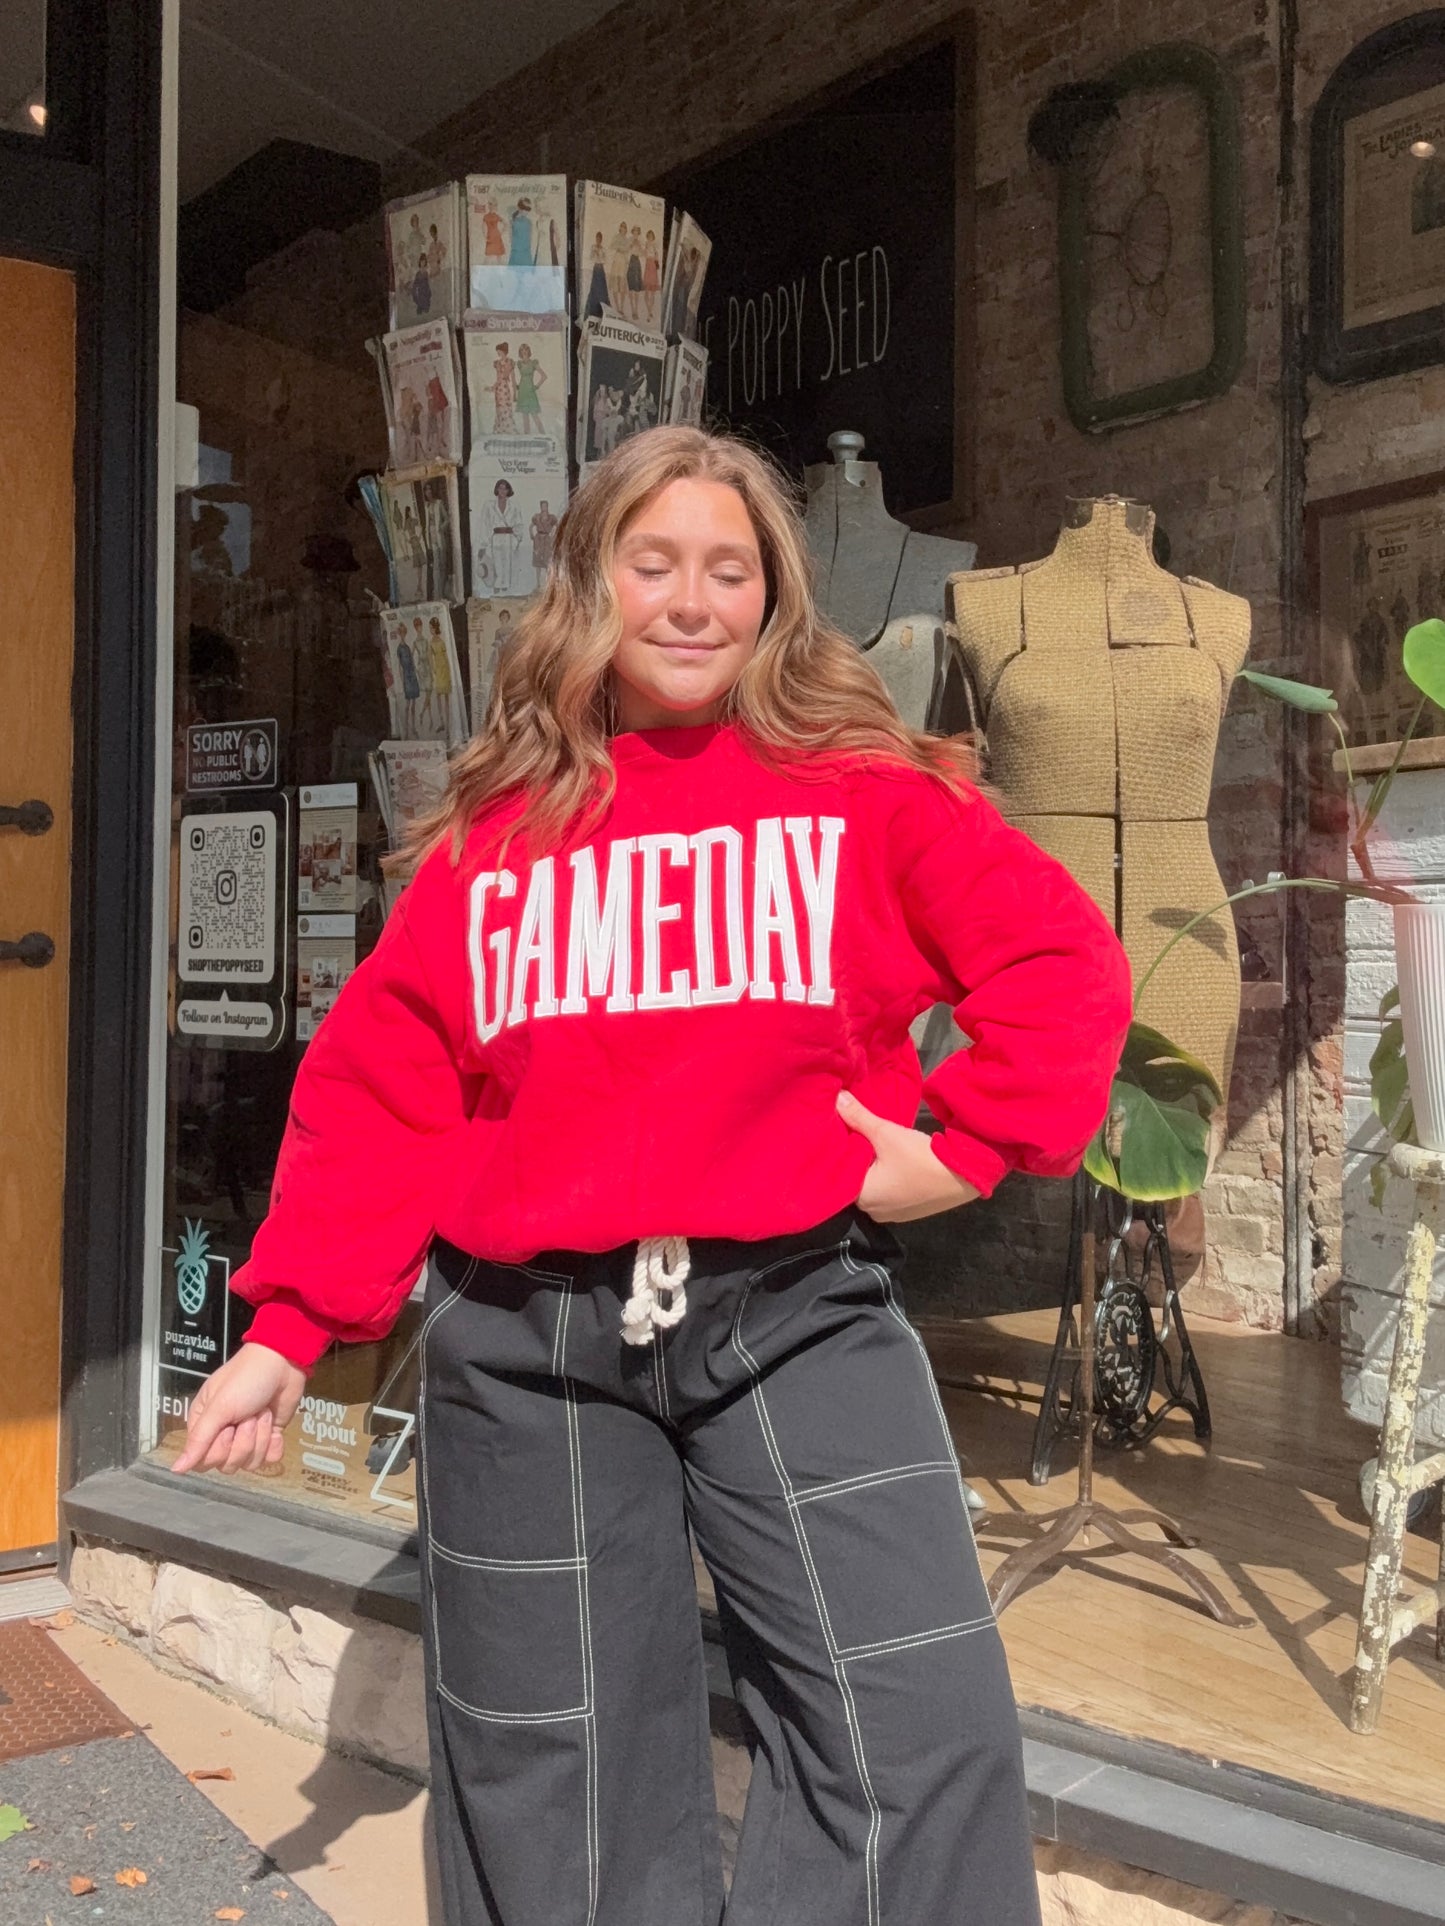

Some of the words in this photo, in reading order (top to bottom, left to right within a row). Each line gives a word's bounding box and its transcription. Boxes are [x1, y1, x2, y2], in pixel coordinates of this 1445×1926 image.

[487, 315, 542, 330] Simplicity
[729, 276, 805, 413] POPPY
[820, 246, 890, 381] SEED
[192, 730, 242, 752] SORRY
[206, 754, 238, 767] PUBLIC
[192, 769, 242, 784] RESTROOMS
[469, 816, 846, 1044] GAMEDAY
[187, 958, 264, 973] SHOPTHEPOPPYSEED
[181, 1009, 209, 1023] Follow
[210, 1014, 221, 1024] on
[223, 1011, 268, 1030] Instagram
[165, 1329, 216, 1352] puravida
[172, 1347, 185, 1358] LIVE
[193, 1349, 207, 1362] FREE
